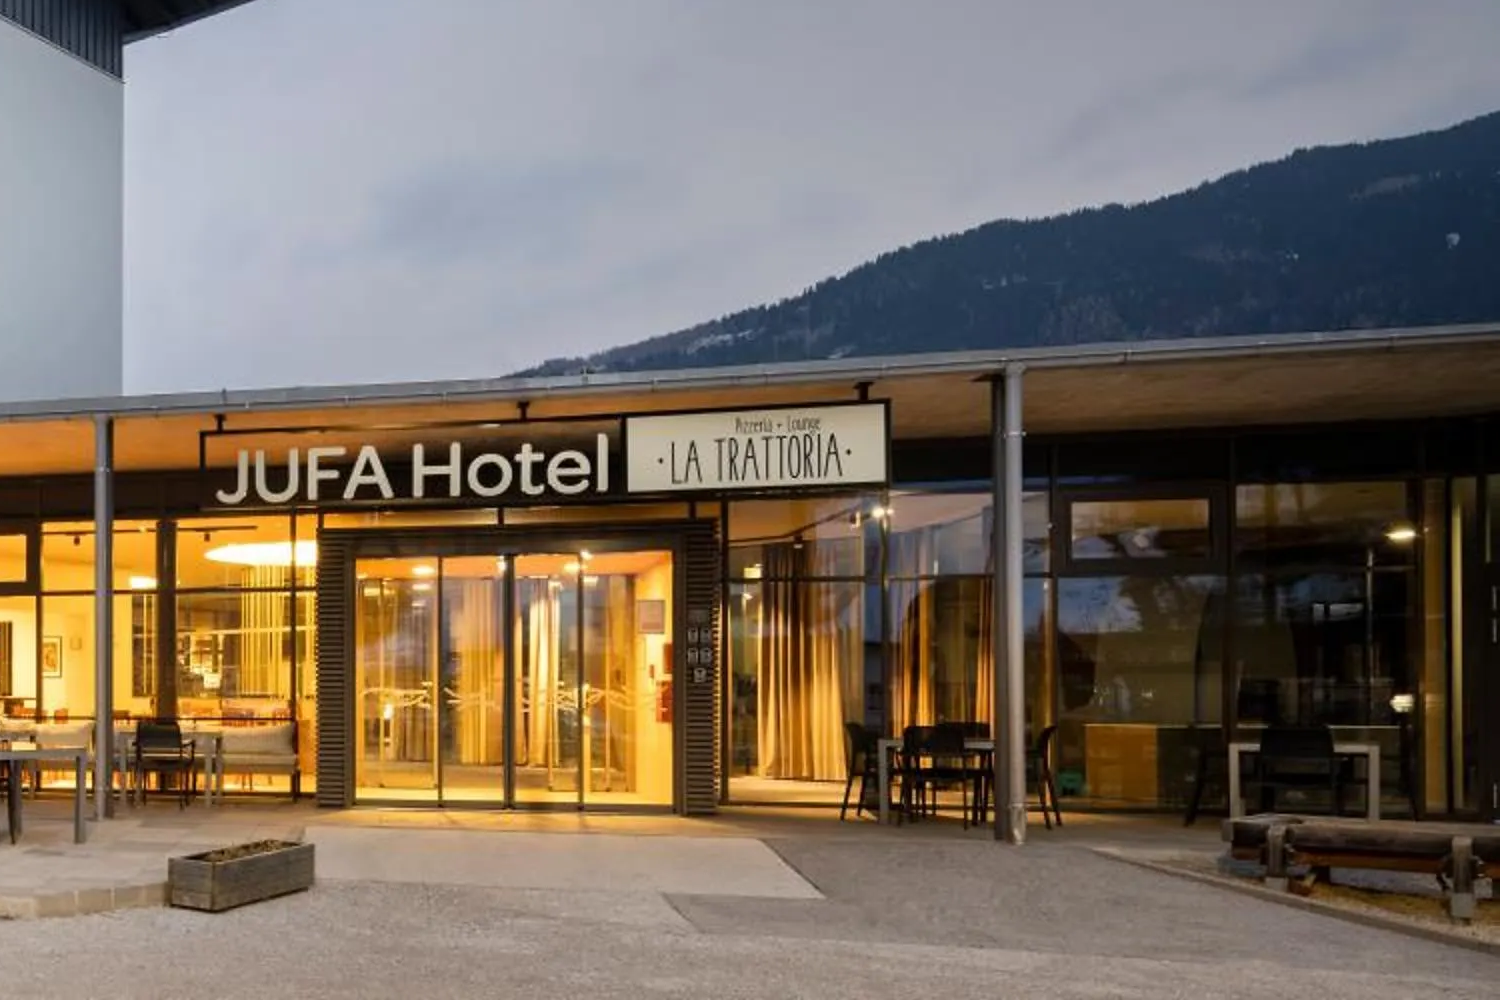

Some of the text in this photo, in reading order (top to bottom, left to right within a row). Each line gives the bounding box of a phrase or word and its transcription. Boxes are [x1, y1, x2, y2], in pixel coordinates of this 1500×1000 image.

[735, 416, 773, 434] Pizzeria
[787, 413, 821, 435] Lounge
[216, 432, 609, 504] JUFA Hotel
[671, 432, 844, 485] LA TRATTORIA
